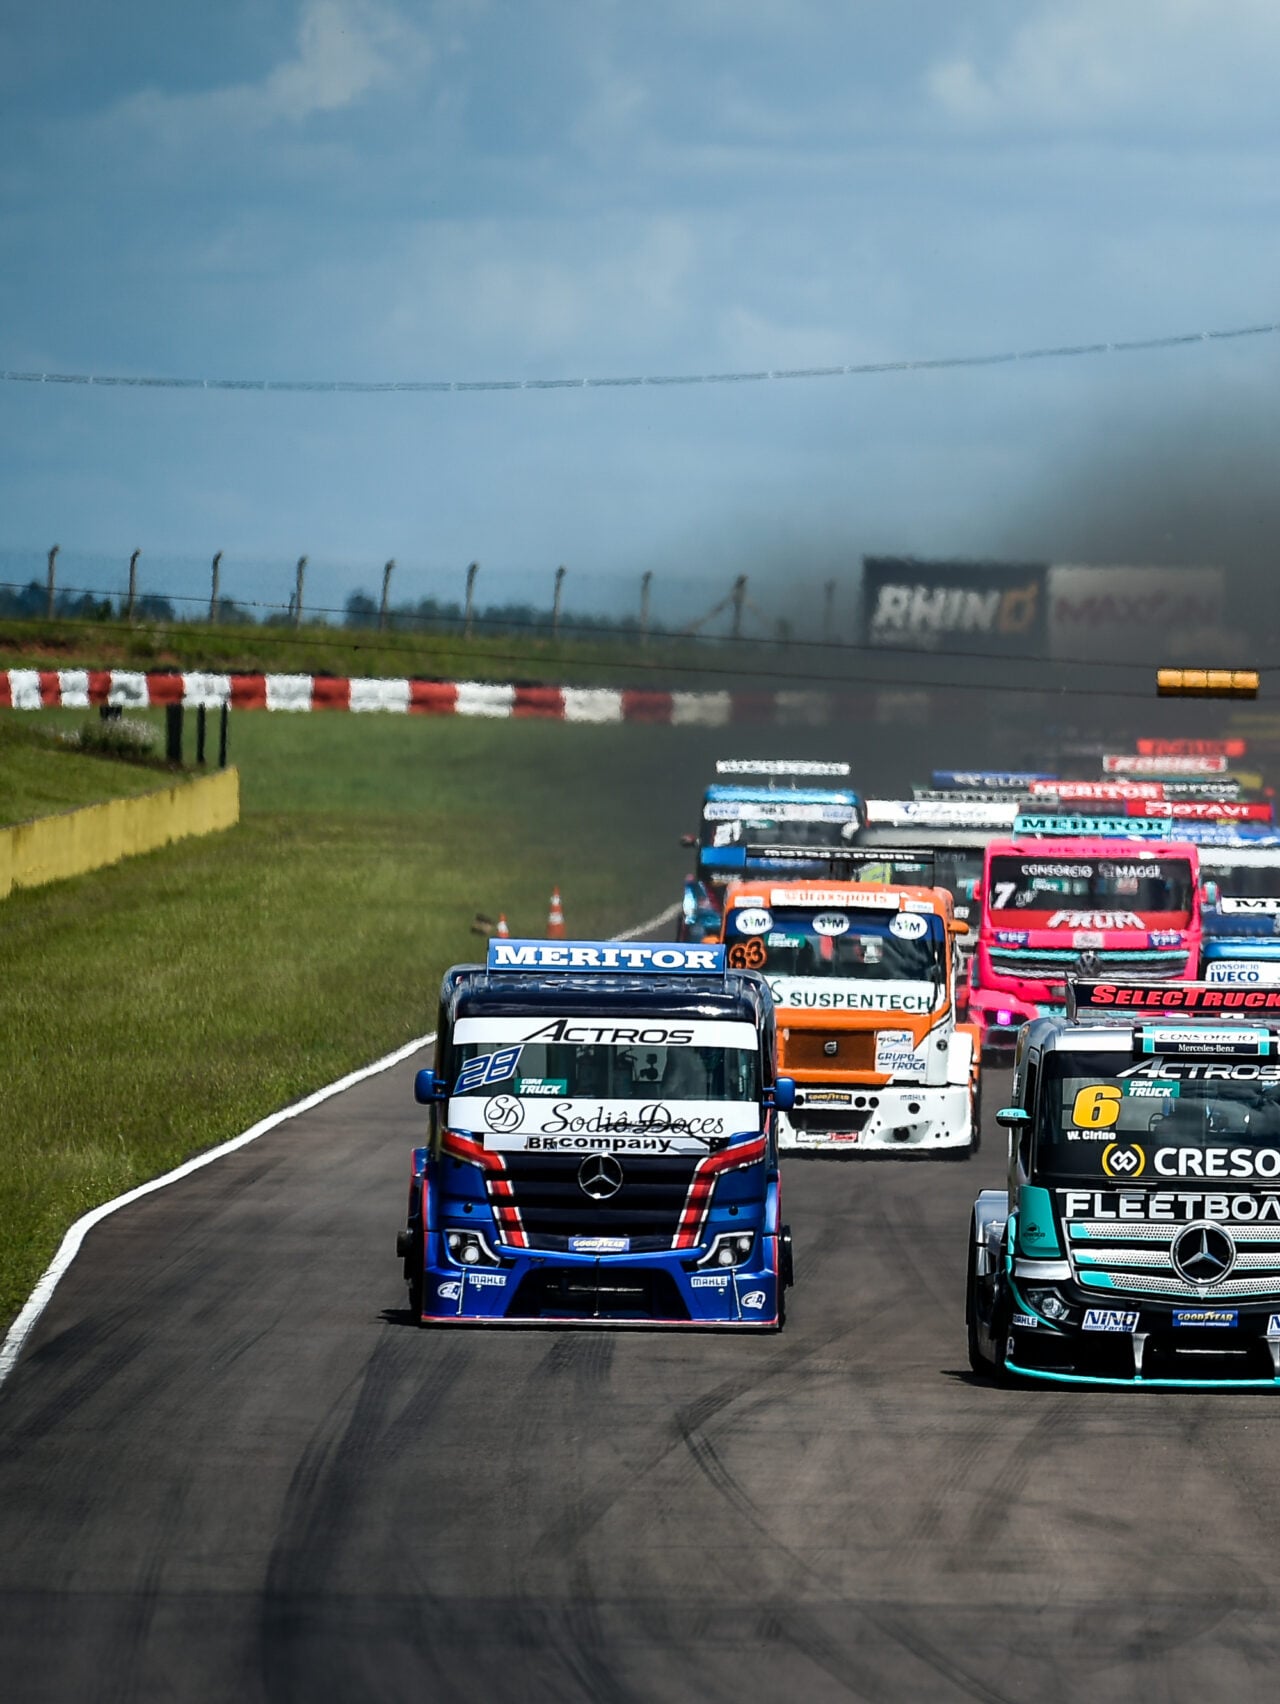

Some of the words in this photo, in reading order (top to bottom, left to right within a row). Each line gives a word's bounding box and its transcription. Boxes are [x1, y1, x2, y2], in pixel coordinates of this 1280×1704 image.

[872, 583, 1038, 634] RHINO
[1022, 818, 1165, 832] MERITOR
[993, 881, 1017, 909] 7
[495, 945, 716, 969] MERITOR
[729, 937, 768, 969] 83
[1210, 971, 1260, 982] IVECO
[790, 991, 933, 1010] SUSPENTECH
[1159, 1033, 1254, 1042] CONSORCIO
[1178, 1044, 1236, 1053] Mercedes-Benz
[877, 1053, 916, 1061] GRUPO
[453, 1044, 526, 1096] 28
[892, 1062, 926, 1070] TROCA
[518, 1084, 562, 1095] TRUCK
[1128, 1088, 1173, 1097] TRUCK
[1072, 1084, 1123, 1129] 6
[633, 1100, 725, 1133] Doces
[470, 1275, 506, 1285] MAHLE
[692, 1278, 727, 1286] MAHLE
[1177, 1310, 1233, 1322] GOODYEAR
